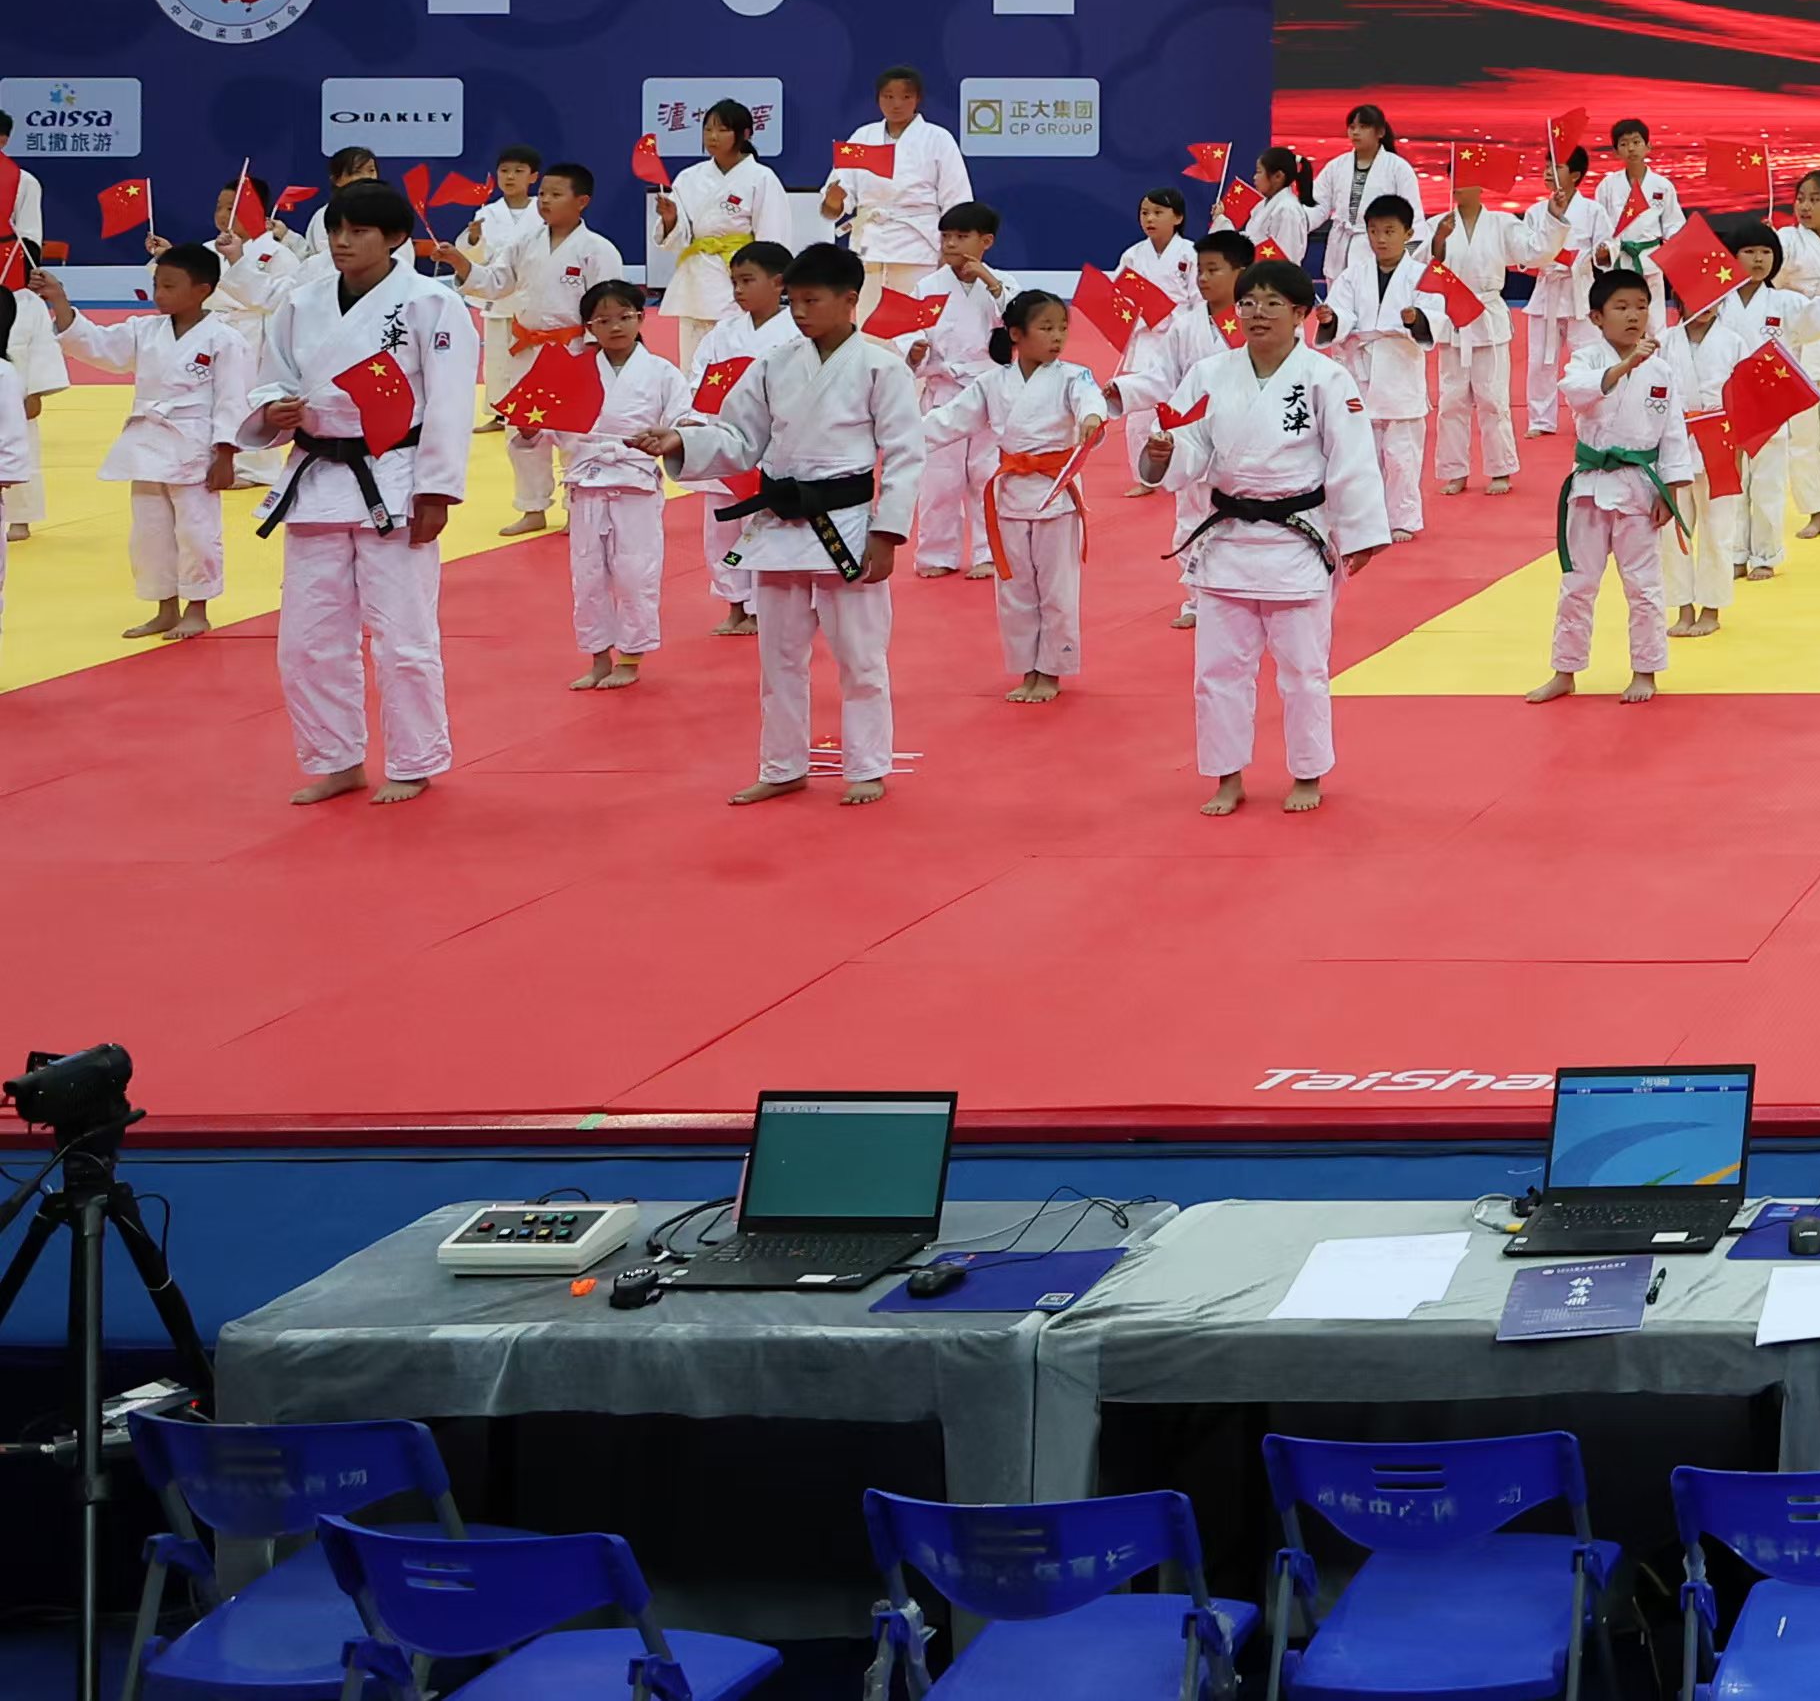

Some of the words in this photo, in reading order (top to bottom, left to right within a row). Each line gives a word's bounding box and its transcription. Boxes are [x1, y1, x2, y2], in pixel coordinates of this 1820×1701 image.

[170, 4, 300, 39] 中国柔道协会
[26, 109, 113, 128] caissa
[1009, 100, 1094, 119] 正大集团
[1009, 122, 1030, 135] CP
[1034, 122, 1094, 135] GROUP
[26, 132, 113, 152] 凯撒旅游
[380, 303, 409, 354] 天津
[1282, 384, 1311, 435] 天津
[1253, 1068, 1557, 1091] TaiSha
